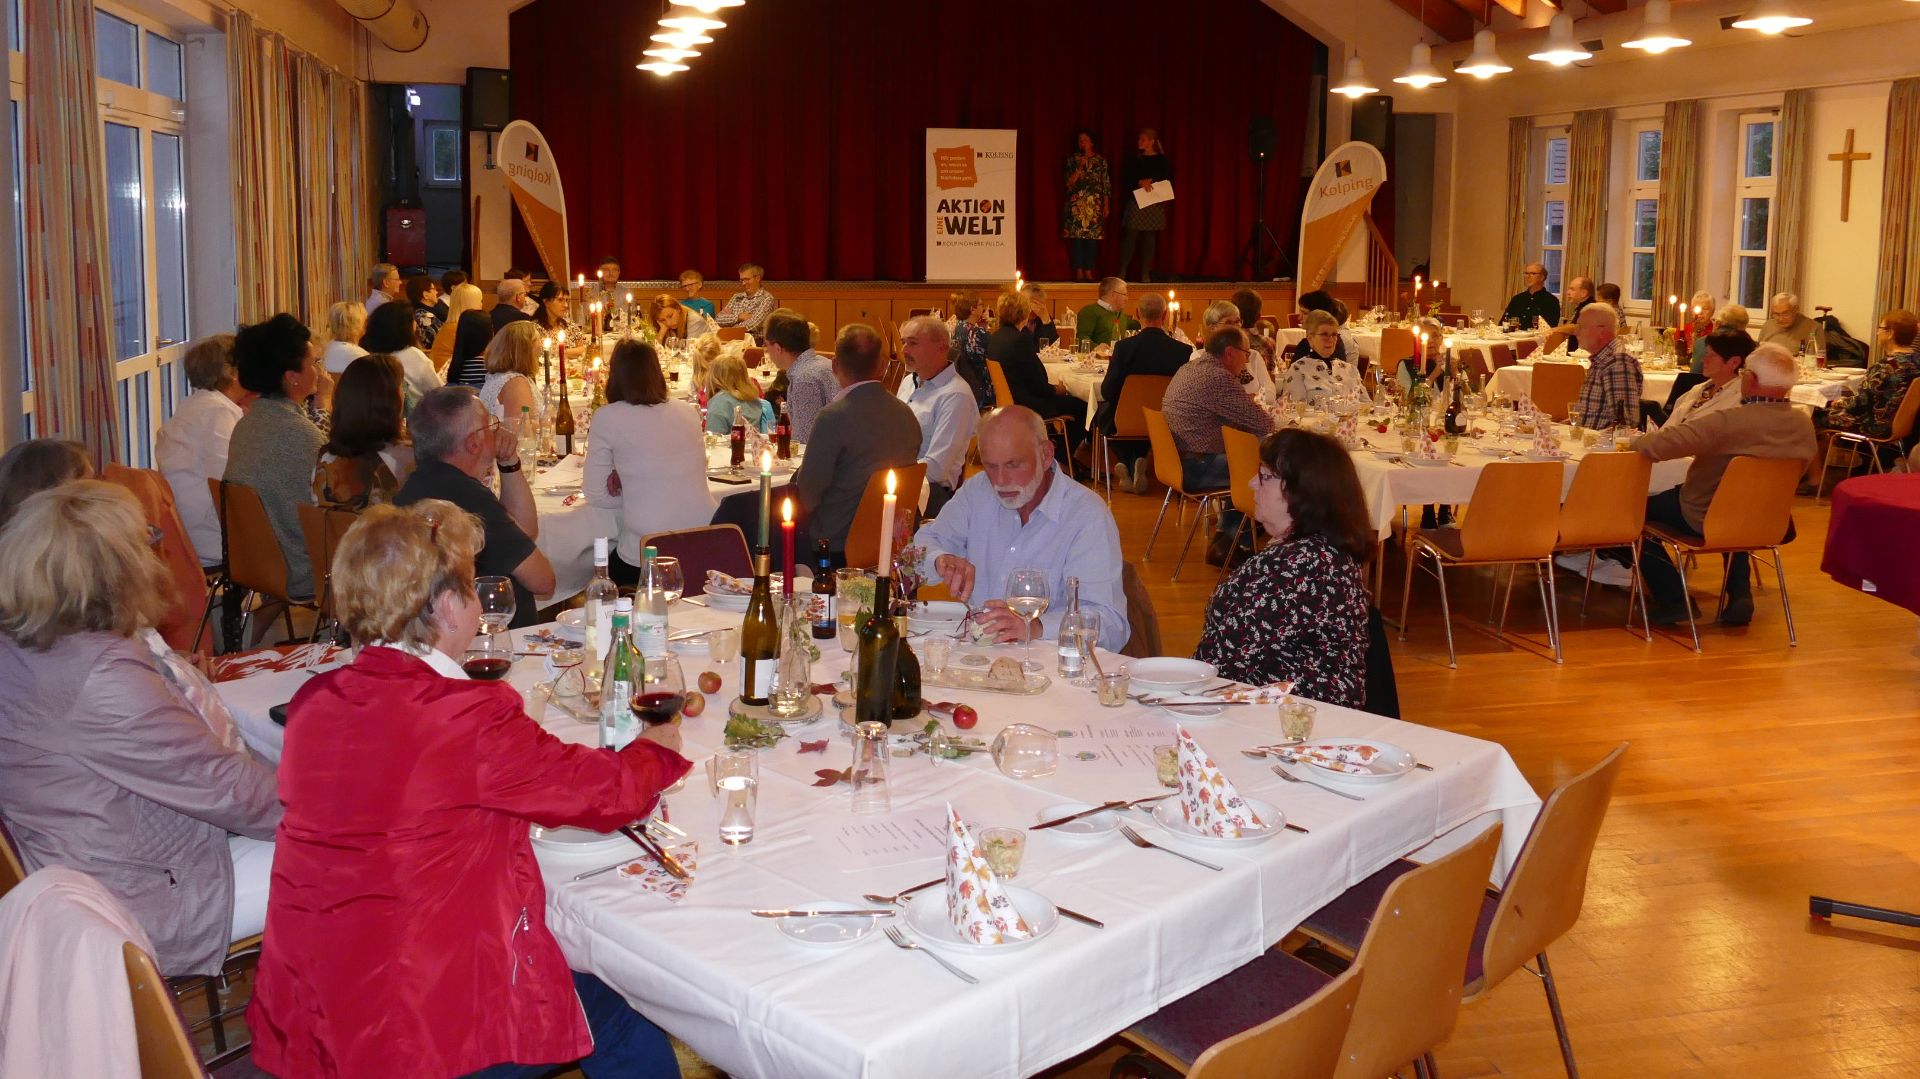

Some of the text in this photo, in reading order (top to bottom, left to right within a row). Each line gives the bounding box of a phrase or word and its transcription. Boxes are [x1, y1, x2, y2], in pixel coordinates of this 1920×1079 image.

[1319, 177, 1374, 198] Kolping
[937, 199, 1005, 213] AKTION
[944, 216, 1005, 235] WELT
